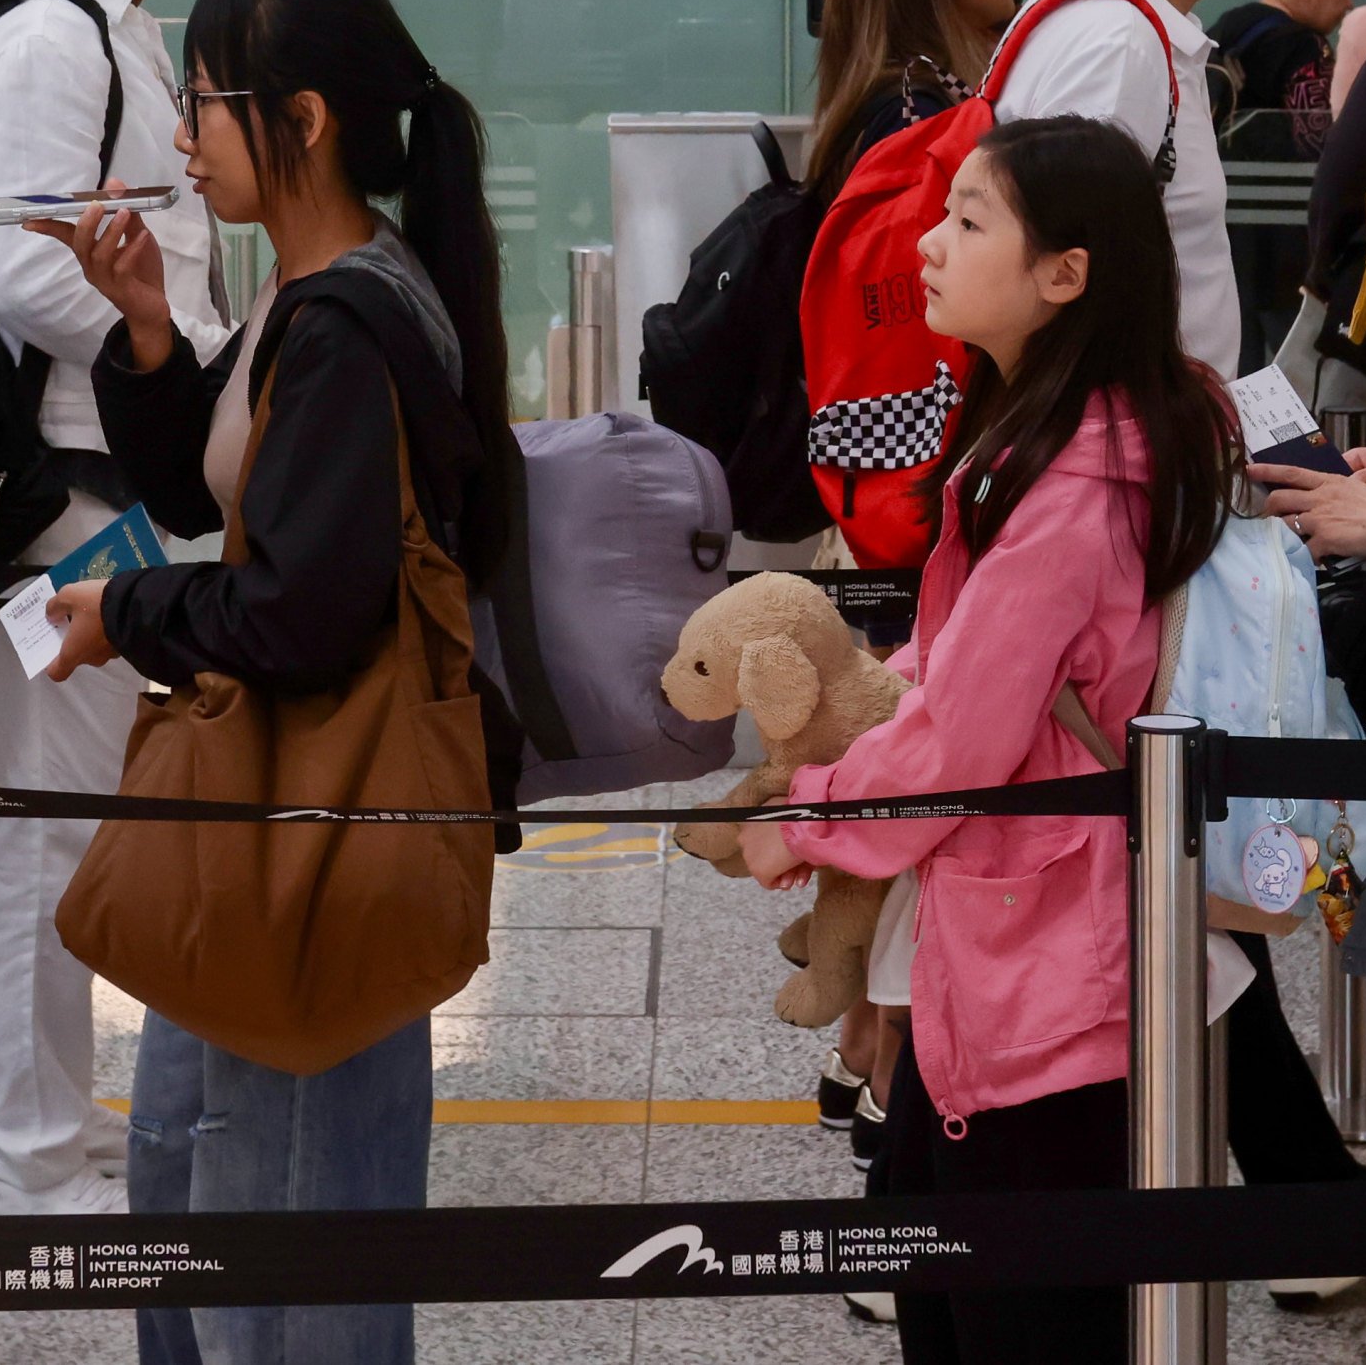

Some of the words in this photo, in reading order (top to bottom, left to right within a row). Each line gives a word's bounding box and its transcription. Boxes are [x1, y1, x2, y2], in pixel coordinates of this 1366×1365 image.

[838, 1228, 886, 1240] HONG
[891, 1226, 938, 1238] KONG
[780, 1230, 824, 1252] 香港
[89, 1244, 137, 1256] HONG
[142, 1243, 190, 1255] KONG
[838, 1242, 972, 1256] INTERNATIONAL
[29, 1246, 75, 1267] 香港
[89, 1260, 224, 1272] INTERNATIONAL
[732, 1253, 824, 1275] 國際機場
[838, 1260, 911, 1273] AIRPORT
[89, 1277, 163, 1289] AIRPORT
